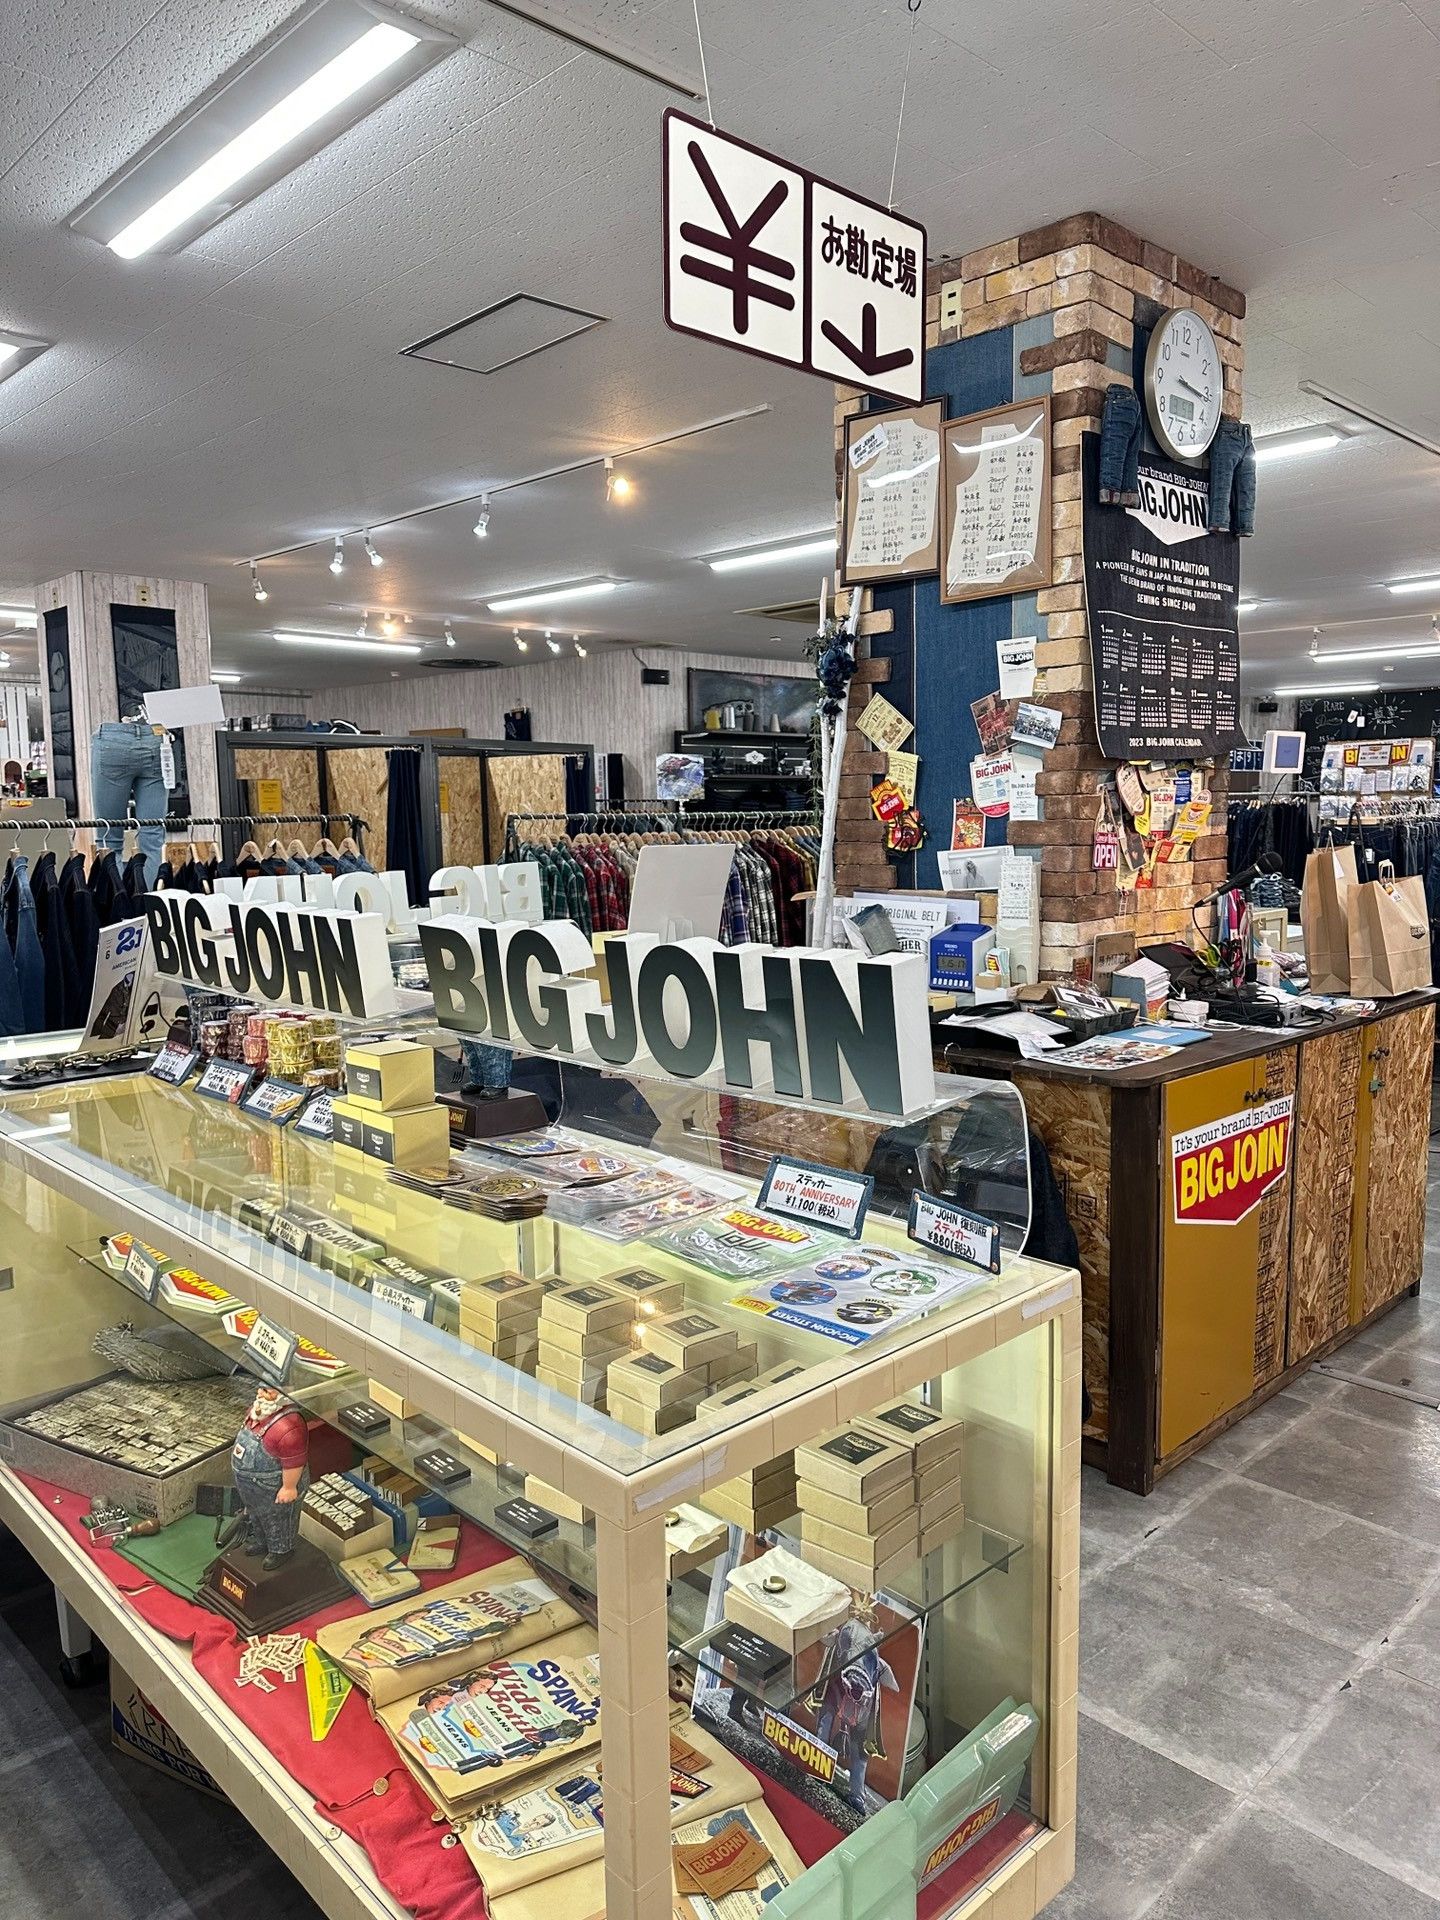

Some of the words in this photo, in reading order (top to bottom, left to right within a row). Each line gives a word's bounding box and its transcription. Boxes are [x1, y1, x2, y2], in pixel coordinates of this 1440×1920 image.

[821, 215, 917, 298] お勘定場
[1172, 328, 1179, 346] 11
[1183, 327, 1191, 345] 12
[1162, 343, 1171, 361] 10
[1151, 468, 1173, 483] brand
[1174, 474, 1209, 491] BIG-JOHN
[1158, 486, 1207, 527] JOHN
[1095, 561, 1101, 569] A
[1102, 561, 1129, 572] PIONEER
[1210, 581, 1217, 589] TO
[1131, 548, 1140, 561] BIG
[1140, 552, 1158, 567] JOHN
[1160, 557, 1170, 569] IN
[1171, 559, 1210, 576] TRADITION
[1120, 574, 1128, 583] THE
[1156, 584, 1165, 592] OF
[1136, 592, 1160, 606] SEWING
[1162, 597, 1180, 609] SINCE
[1181, 601, 1196, 612] 1940
[1015, 652, 1033, 661] JOHN
[1129, 737, 1144, 747] 2023
[1146, 738, 1158, 747] BIG
[975, 767, 989, 779] BIG
[989, 762, 1012, 776] JOHN
[1094, 843, 1117, 868] OPEN
[921, 910, 941, 922] BELT
[105, 950, 111, 960] 6
[145, 893, 223, 988] BIG
[225, 902, 368, 1019] JOHN
[418, 922, 576, 1054] BIG
[584, 939, 905, 1116] JOHN
[1174, 1136, 1193, 1154] It's
[1194, 1128, 1221, 1153] your
[1221, 1115, 1251, 1136] brand
[795, 1173, 833, 1189] ステッカー
[1180, 1146, 1225, 1211] BIG
[773, 1179, 796, 1194] 80TH
[800, 1186, 858, 1210] ANNIVERSARY
[724, 1210, 757, 1228] BIG
[756, 1218, 806, 1244] JOHN
[934, 1219, 972, 1241] ステッカー
[936, 1207, 958, 1226] JOHN
[960, 1215, 987, 1237] 復刻版
[312, 1222, 338, 1241] BIG
[330, 1234, 369, 1252] JOHN
[381, 1256, 405, 1270] BIG
[395, 1266, 428, 1284] JOHN
[771, 1310, 812, 1330] STICKER
[425, 1599, 471, 1623] Wide
[487, 1660, 542, 1716] Wide
[486, 1705, 512, 1733] JEANS
[443, 1722, 469, 1749] JEANS
[764, 1716, 790, 1749] BIG
[790, 1735, 833, 1779] JOHN
[672, 1777, 701, 1794] JOHN
[690, 1854, 717, 1876] BIG
[712, 1832, 748, 1863] JOHN
